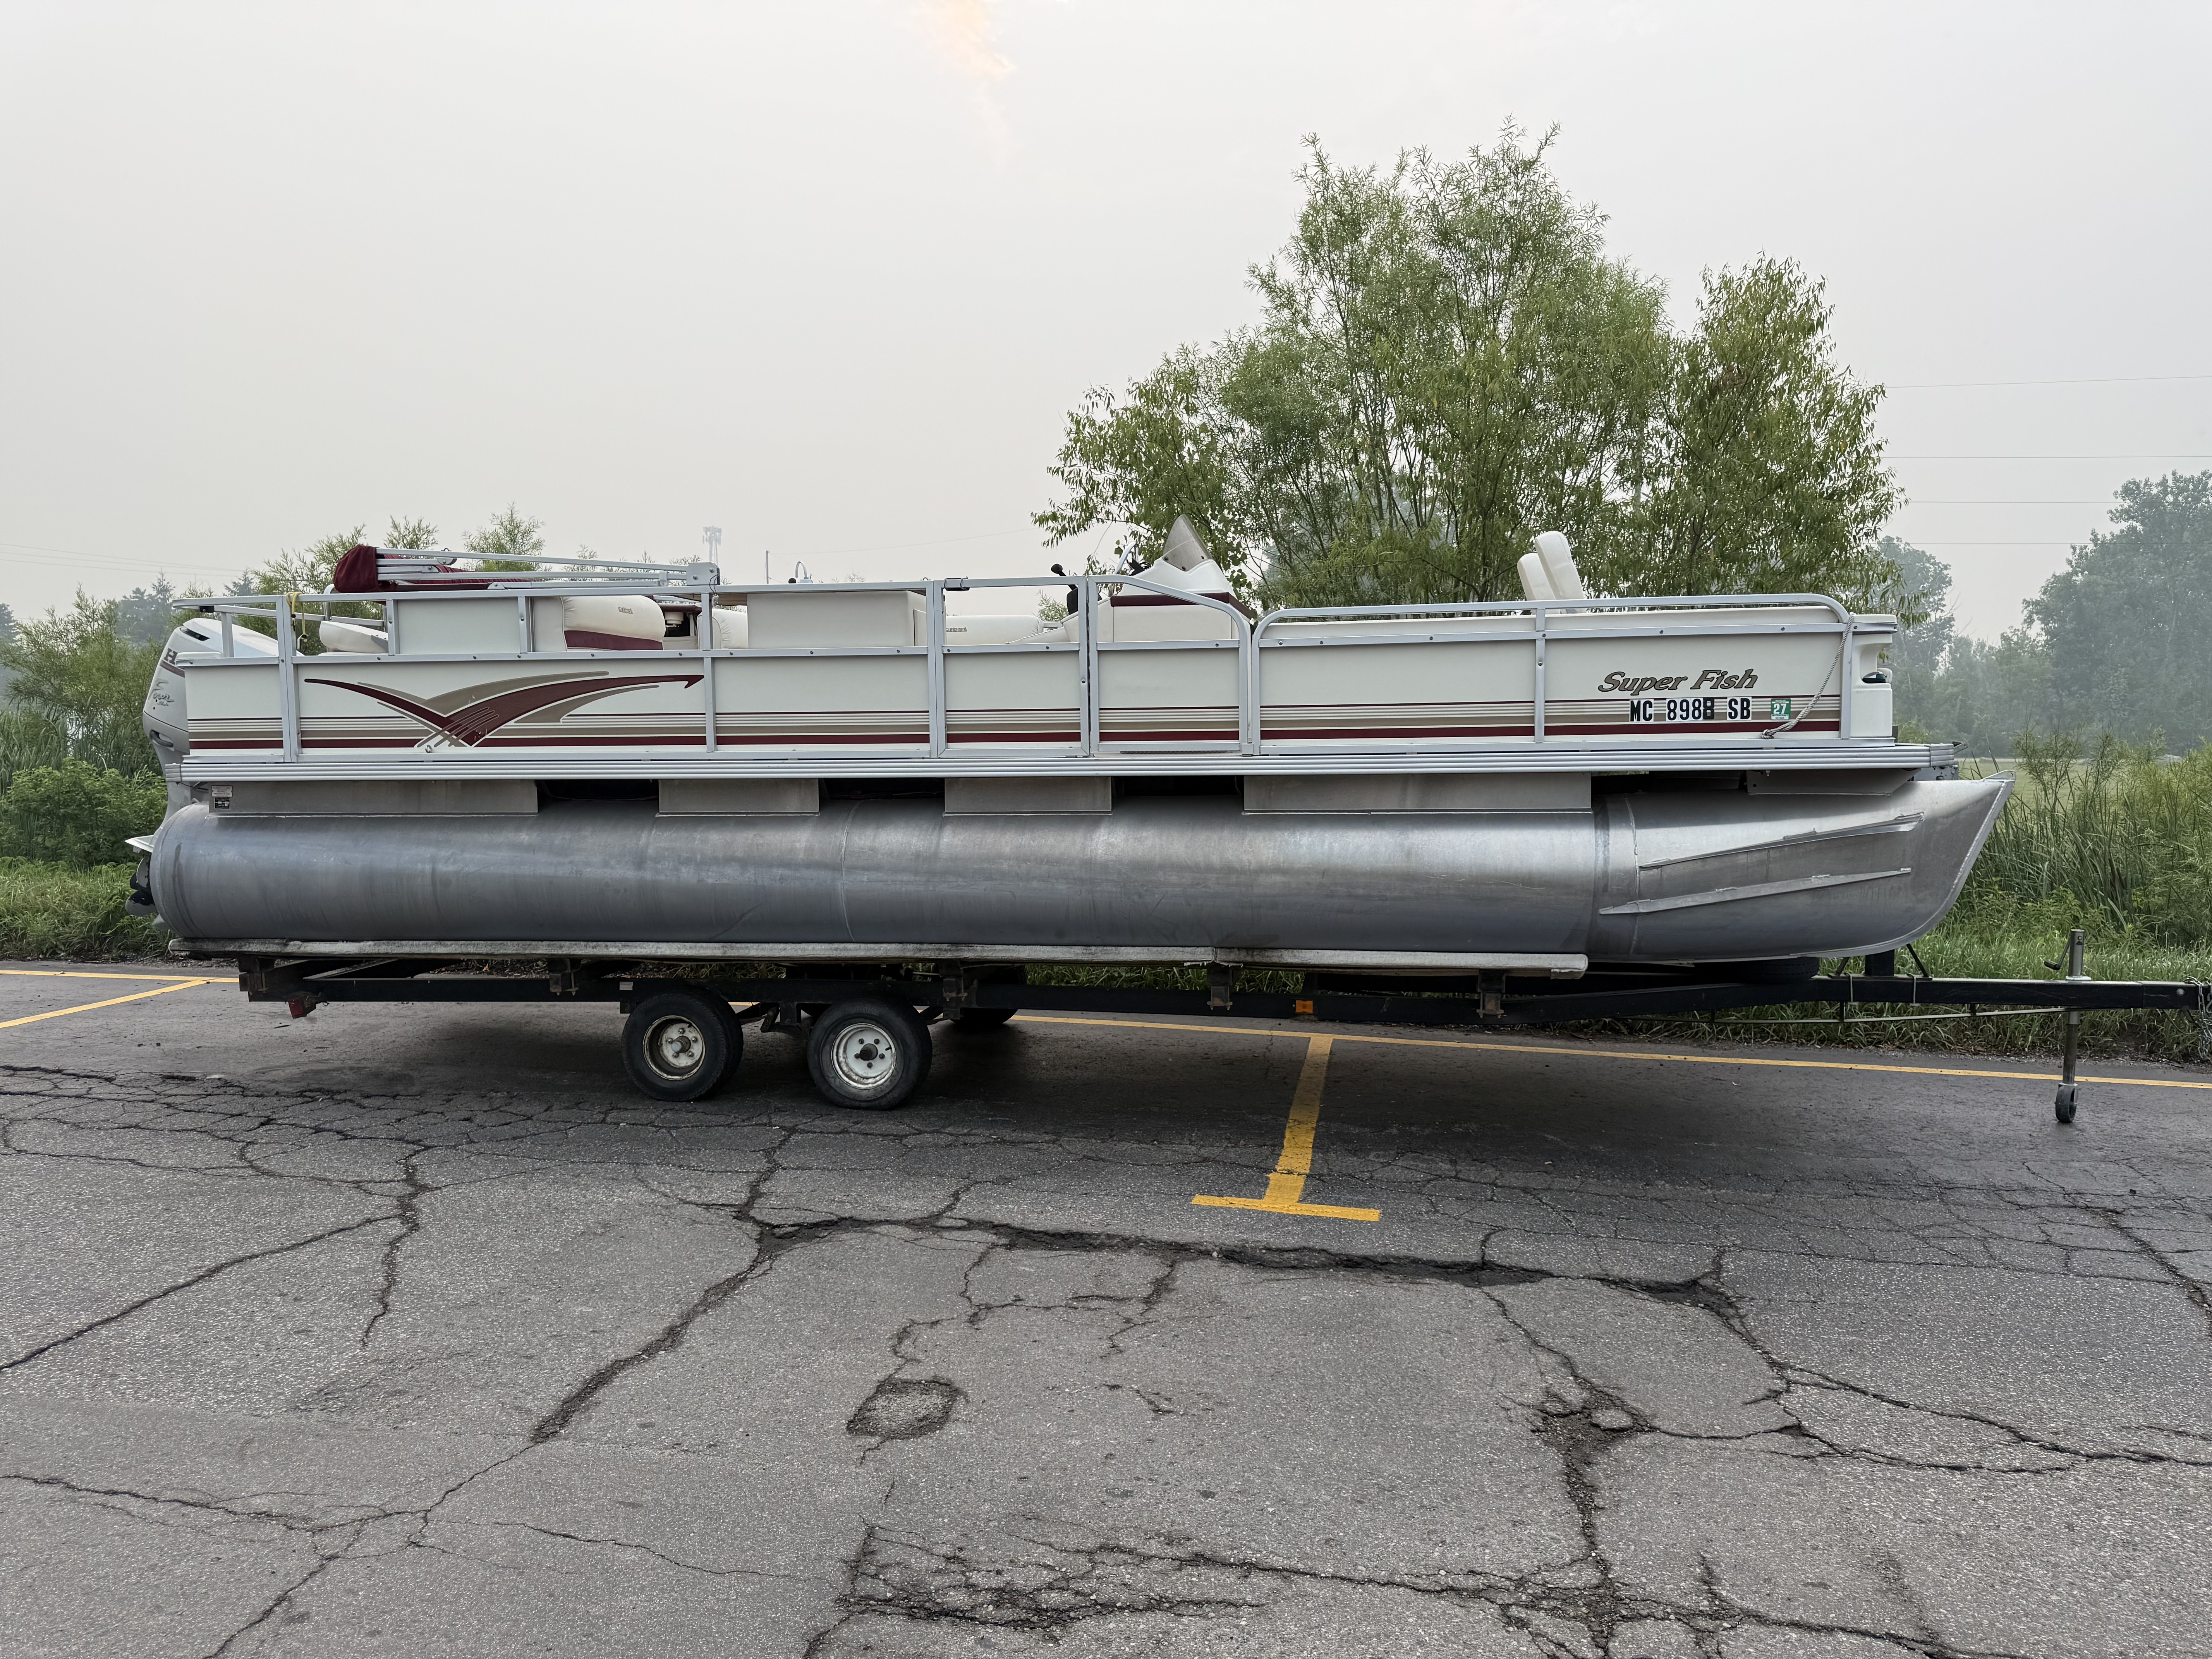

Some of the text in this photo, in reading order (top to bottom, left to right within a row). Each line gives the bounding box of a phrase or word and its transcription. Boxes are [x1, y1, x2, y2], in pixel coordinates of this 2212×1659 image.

[1598, 668, 1758, 696] Super Fish
[1630, 700, 1653, 722] MC
[1728, 698, 1750, 720] SB
[1773, 703, 1786, 714] 27
